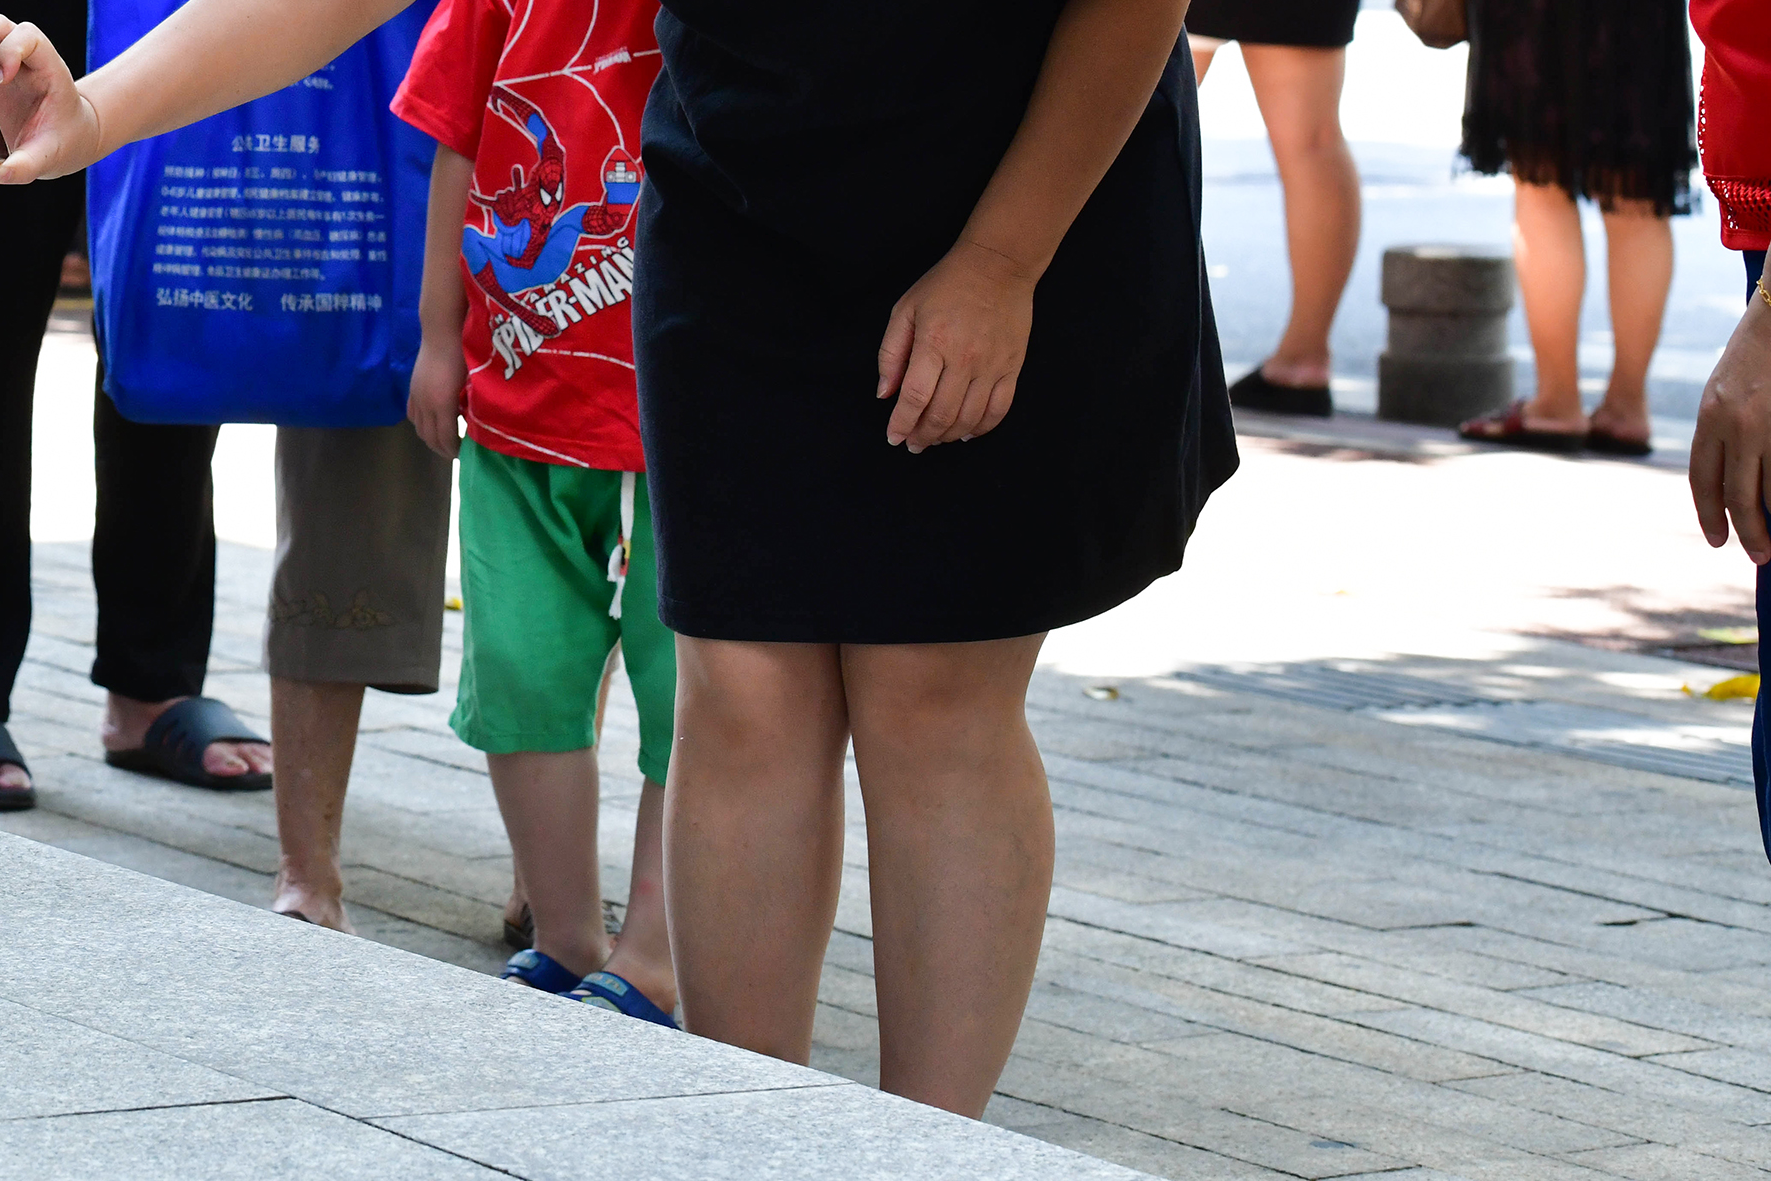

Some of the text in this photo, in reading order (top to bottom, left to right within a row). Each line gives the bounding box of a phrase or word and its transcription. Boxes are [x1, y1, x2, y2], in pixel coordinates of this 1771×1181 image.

[156, 287, 383, 313] 弘扬中医文化 传承国粹精神
